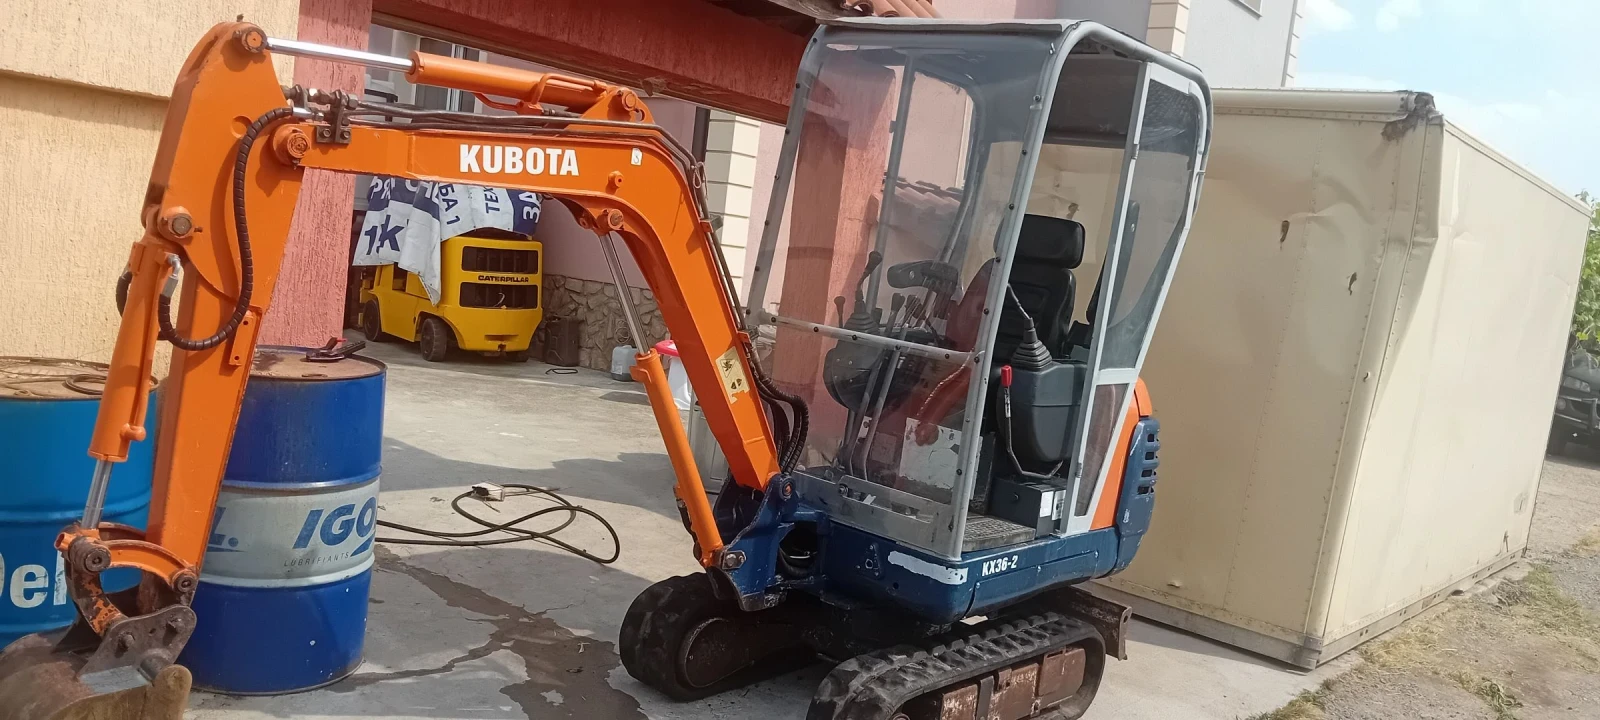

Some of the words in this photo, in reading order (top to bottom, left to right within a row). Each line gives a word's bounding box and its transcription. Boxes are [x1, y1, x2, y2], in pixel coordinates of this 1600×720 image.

[459, 144, 579, 176] KUBOTA
[477, 275, 529, 283] CATERPILLAR
[284, 552, 349, 567] LUBRIFIANTS
[982, 555, 1018, 577] KX36-2
